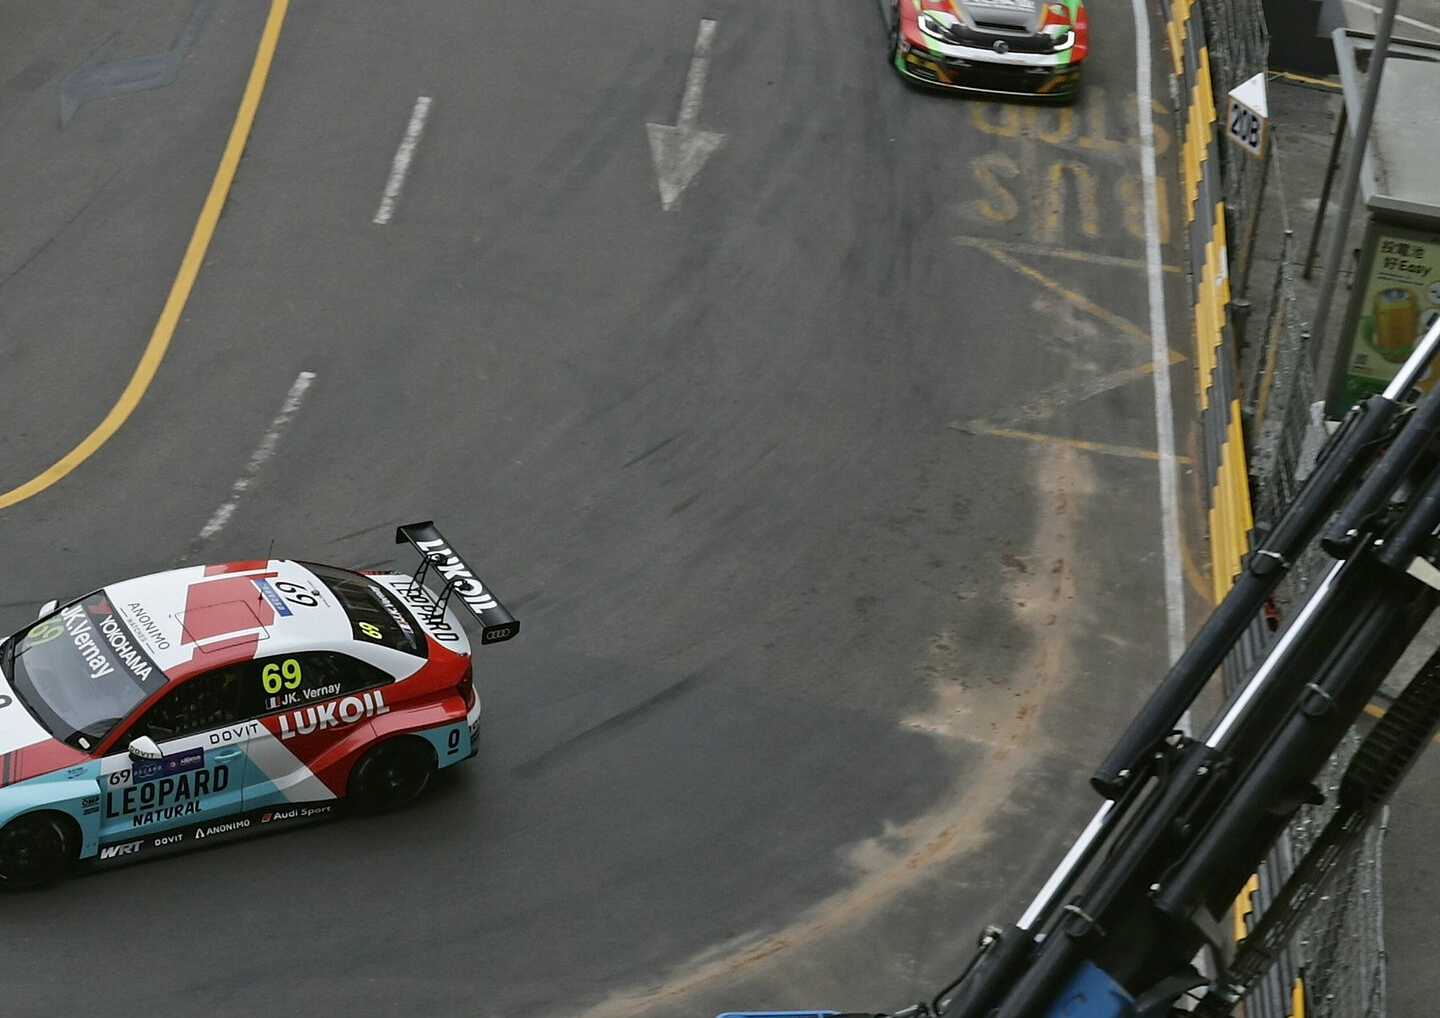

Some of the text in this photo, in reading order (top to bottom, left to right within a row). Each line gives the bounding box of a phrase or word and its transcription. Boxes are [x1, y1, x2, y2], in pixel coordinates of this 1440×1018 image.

[1231, 103, 1259, 148] 20B
[416, 538, 498, 615] LUKOIL
[274, 581, 319, 608] 69
[389, 581, 460, 641] LEOPARD
[26, 616, 65, 647] 69
[127, 602, 170, 651] ANONIMO
[358, 621, 383, 640] 69
[99, 614, 154, 682] YOKOHAMA
[261, 658, 303, 695] 69
[281, 681, 342, 706] JK. Vernay
[277, 689, 391, 741] LUKOIL
[209, 723, 259, 745] DOVIT
[129, 745, 156, 760] DOVIT
[109, 768, 131, 786] 69
[106, 764, 229, 819] LEOPARD
[132, 800, 202, 827] NATURAL
[273, 805, 332, 821] Audi Sport
[154, 833, 184, 847] DOVIT
[206, 819, 251, 836] ANONIMO
[100, 840, 144, 860] WRT
